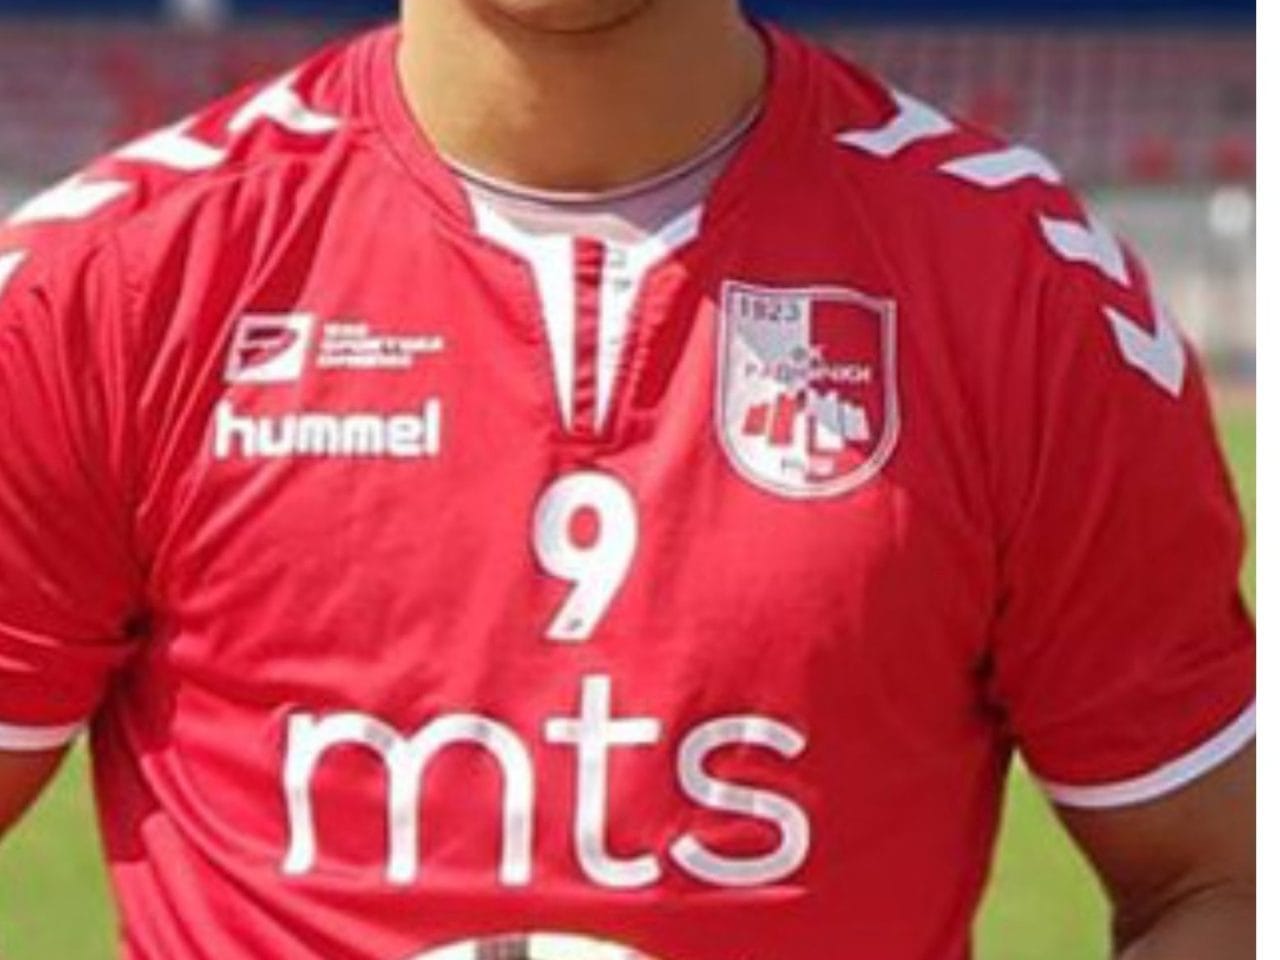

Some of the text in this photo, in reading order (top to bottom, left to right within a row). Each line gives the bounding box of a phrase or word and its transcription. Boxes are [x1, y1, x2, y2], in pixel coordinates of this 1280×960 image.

[215, 397, 440, 459] hummel
[532, 470, 639, 642] 9
[281, 675, 811, 888] mts
